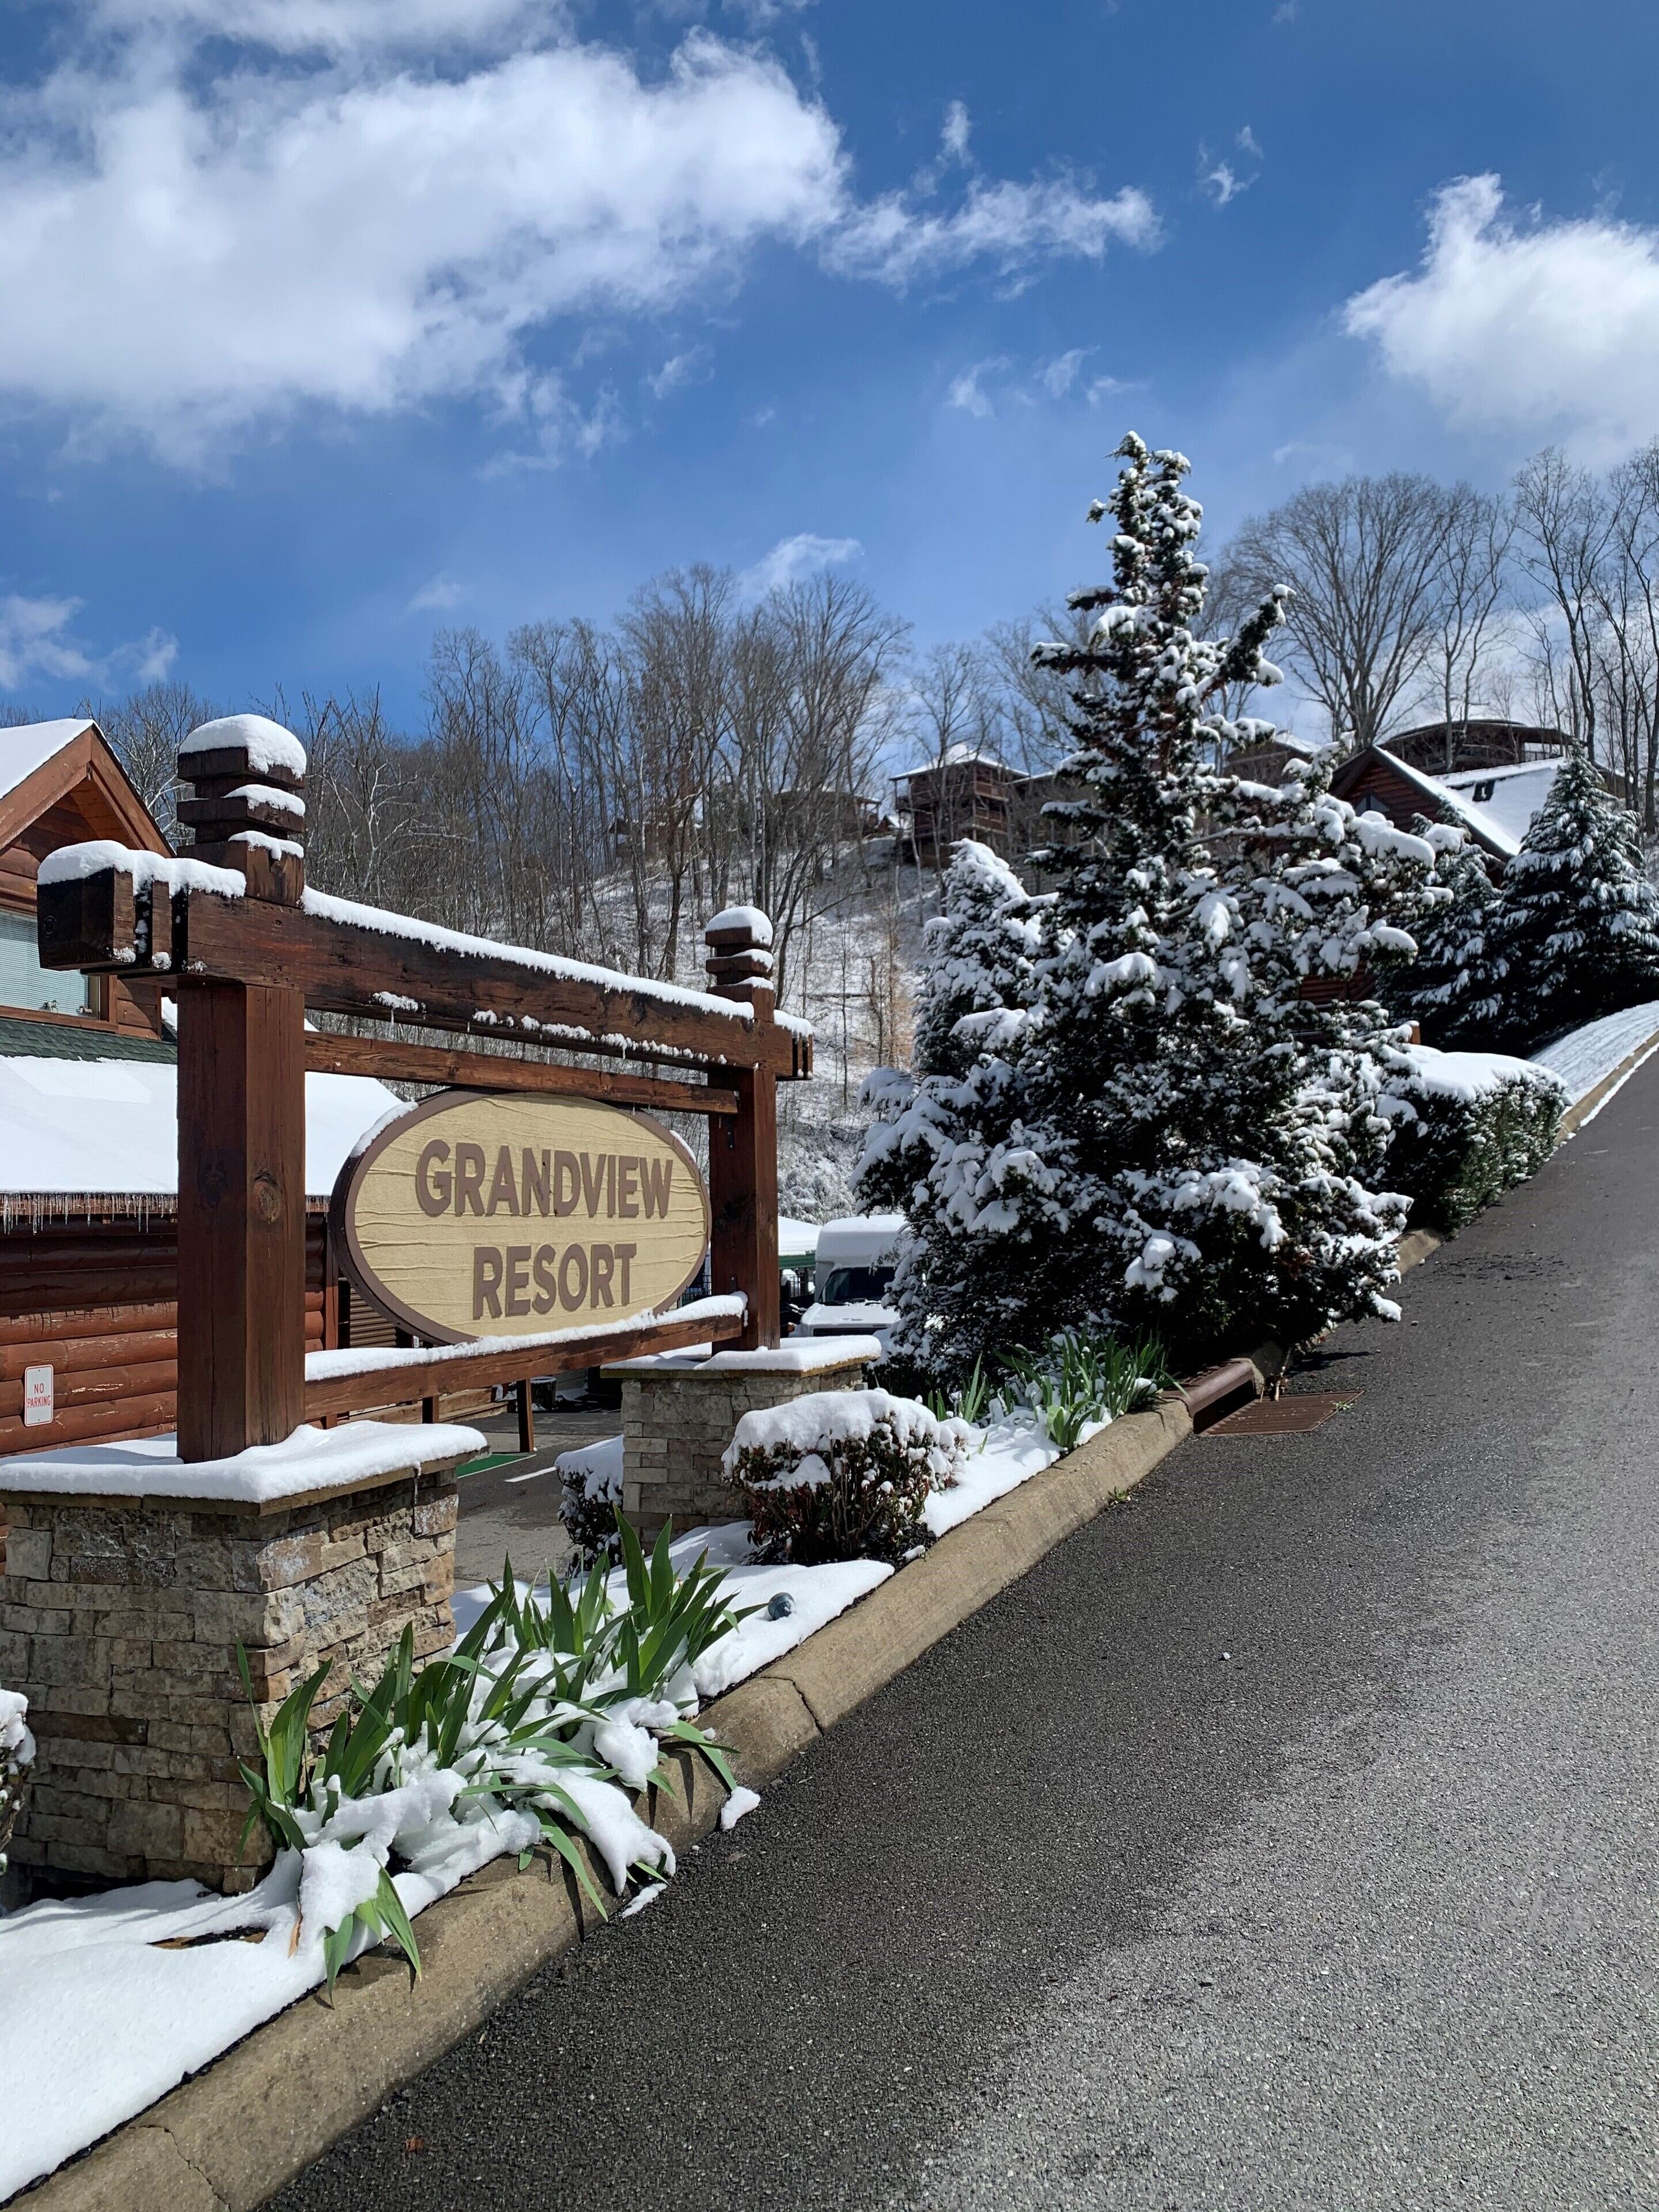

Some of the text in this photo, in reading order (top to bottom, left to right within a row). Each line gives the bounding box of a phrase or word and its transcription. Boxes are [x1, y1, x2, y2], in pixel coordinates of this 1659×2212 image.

[416, 1138, 673, 1219] GRANDVIEW
[473, 1243, 637, 1320] RESORT
[27, 1395, 51, 1408] PARKING
[34, 1383, 44, 1394] NO
